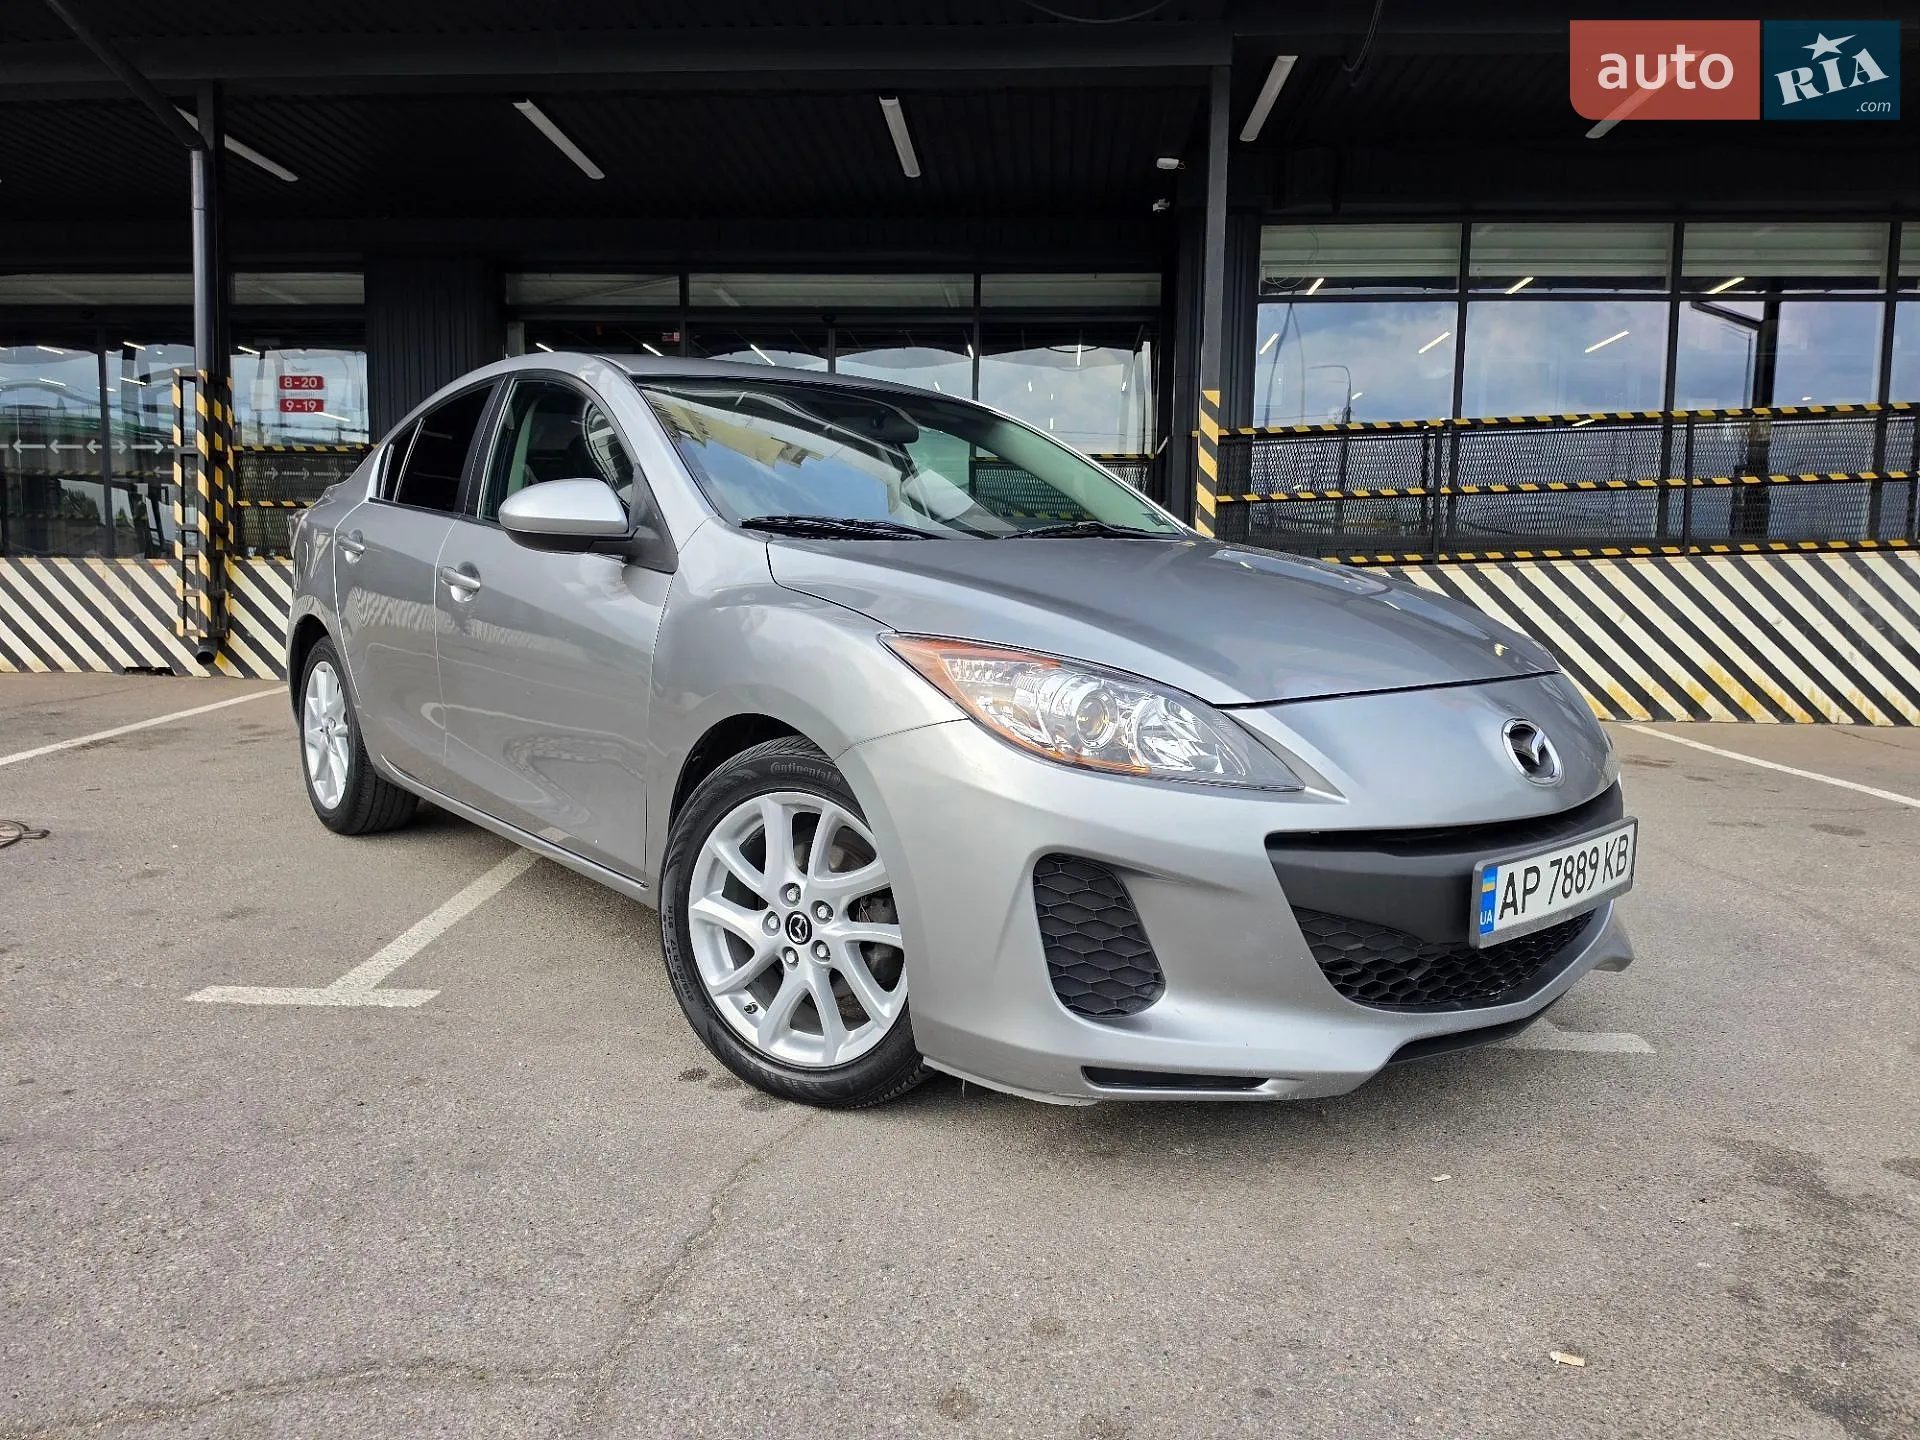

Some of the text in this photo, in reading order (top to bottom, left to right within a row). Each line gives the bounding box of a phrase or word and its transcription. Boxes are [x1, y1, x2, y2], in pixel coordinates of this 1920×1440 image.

[1498, 833, 1629, 920] AP 7889 KB
[1479, 909, 1493, 925] UA
